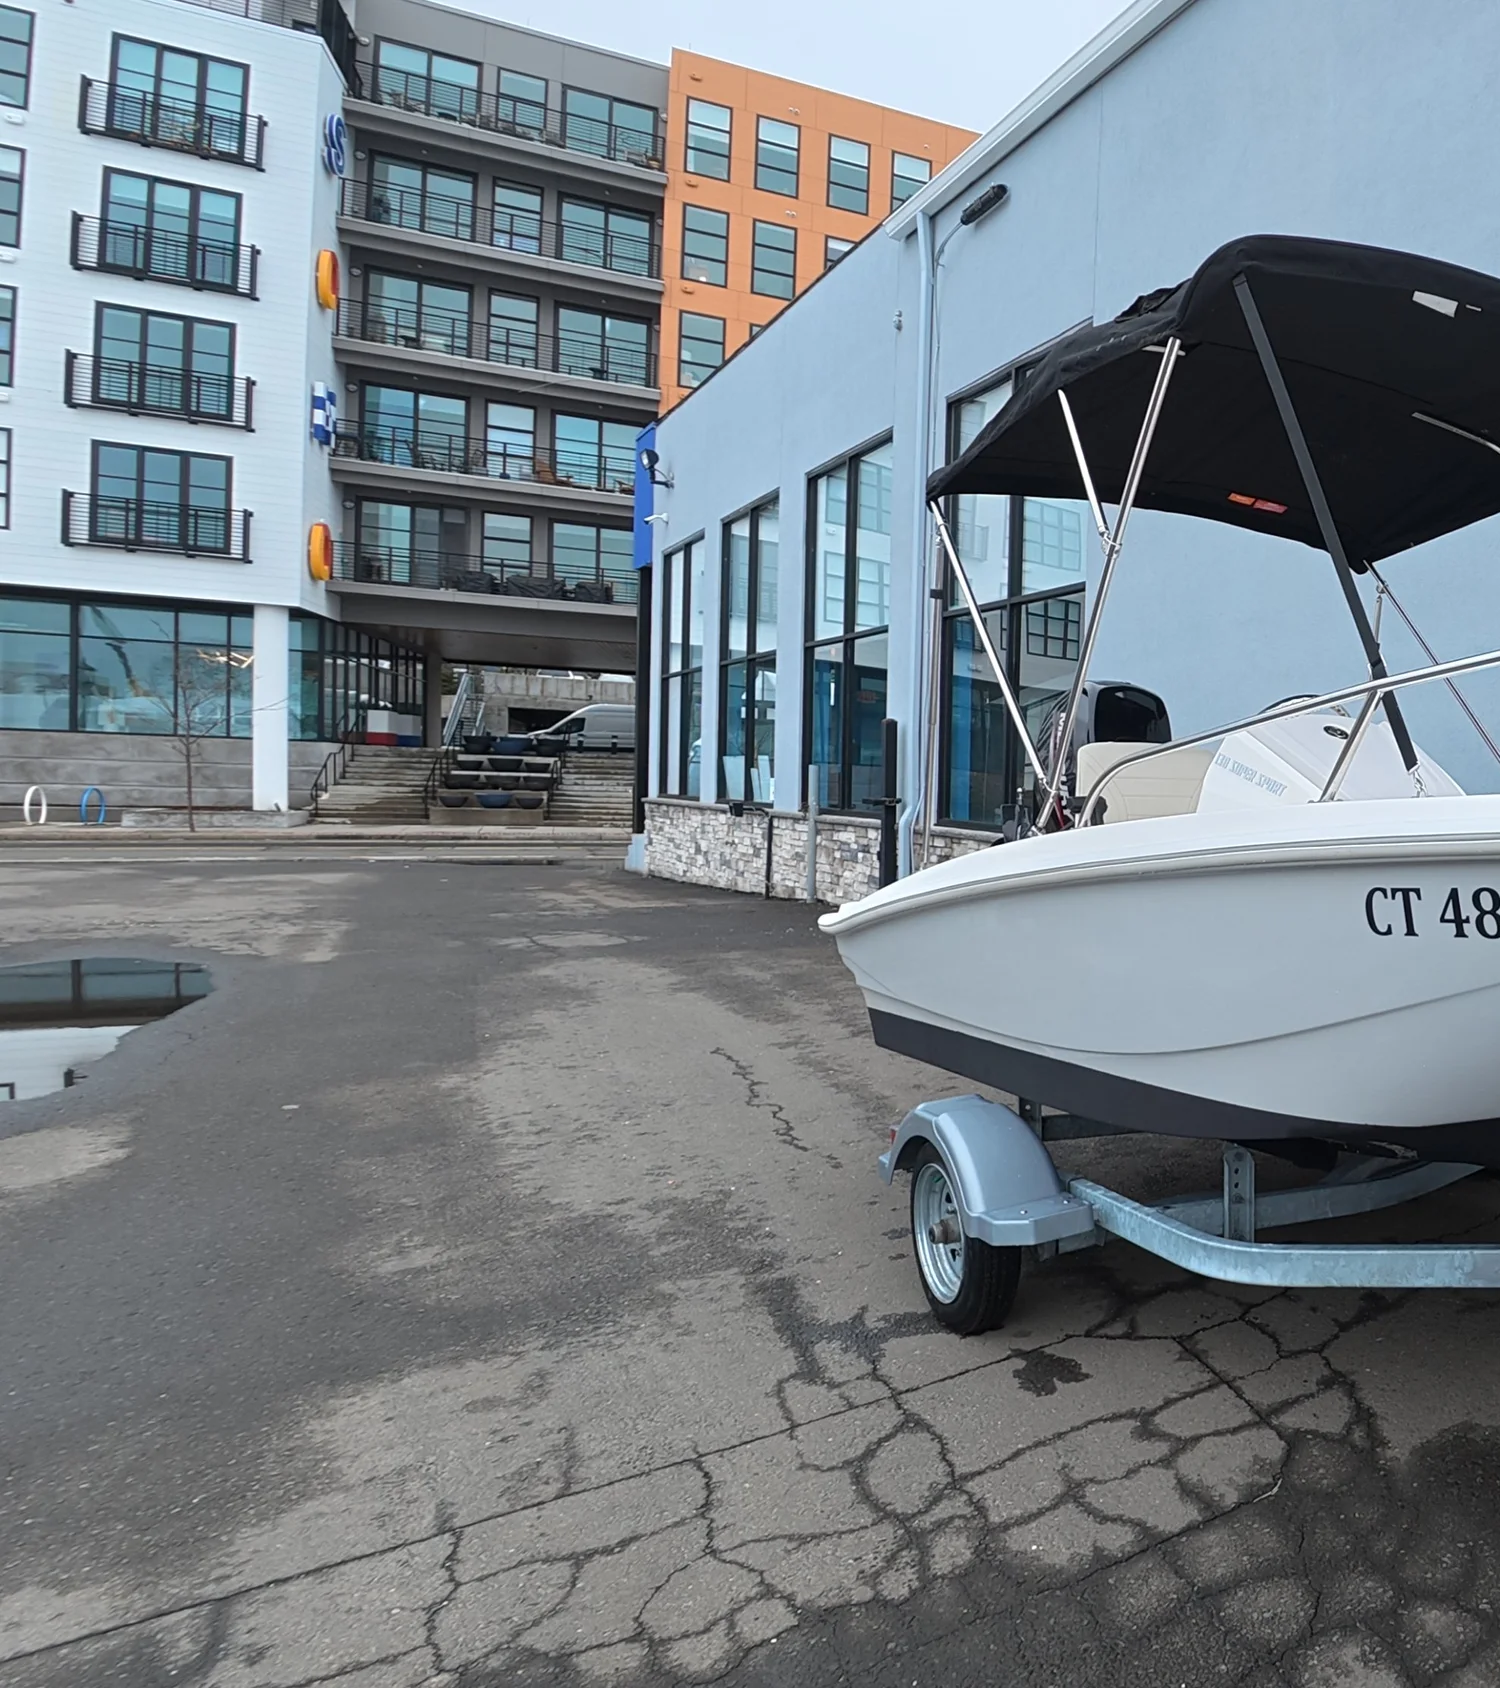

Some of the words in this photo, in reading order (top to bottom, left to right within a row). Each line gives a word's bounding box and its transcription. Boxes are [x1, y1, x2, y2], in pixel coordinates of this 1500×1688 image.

[1228, 759, 1258, 784] SUPER
[1255, 772, 1288, 797] SPORT
[1365, 886, 1422, 937] CT
